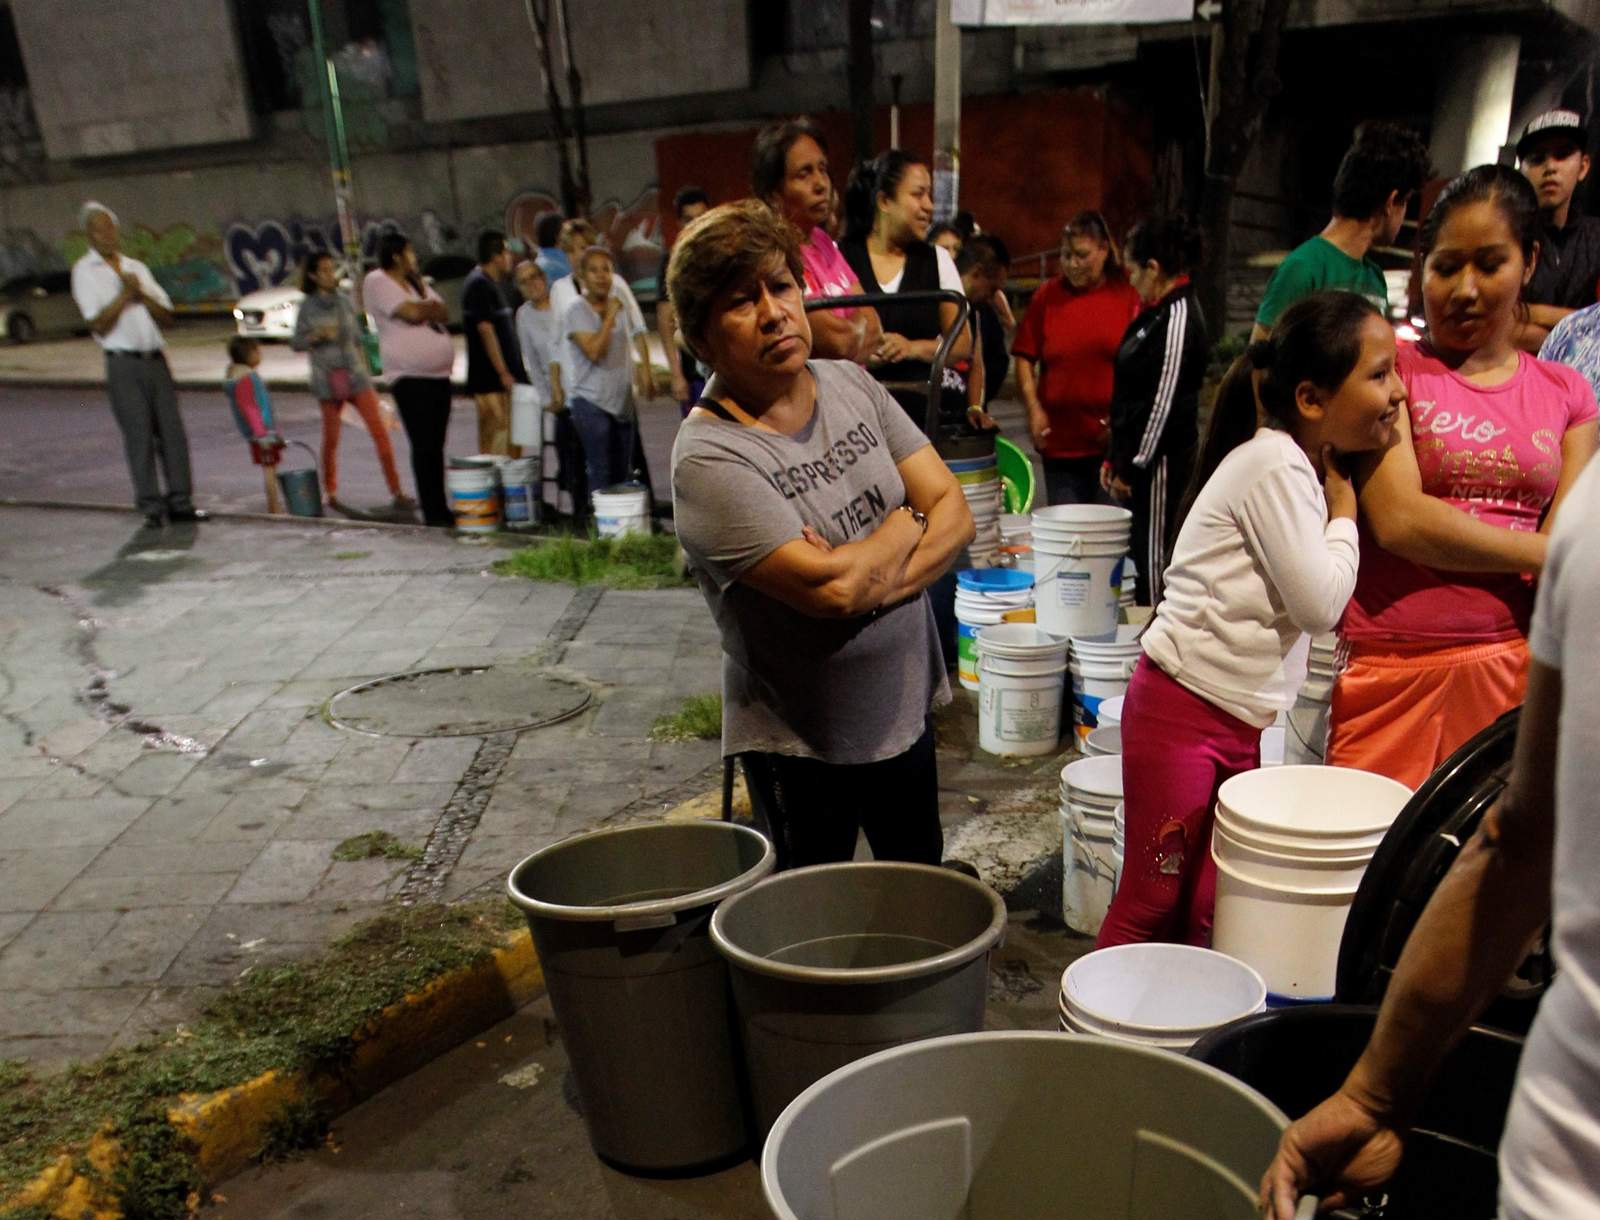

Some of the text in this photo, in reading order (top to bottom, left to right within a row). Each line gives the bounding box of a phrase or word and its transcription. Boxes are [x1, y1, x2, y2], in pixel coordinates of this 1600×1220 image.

[772, 422, 879, 500] ESPRESSO
[831, 484, 886, 540] THEN
[1450, 484, 1512, 505] NEW
